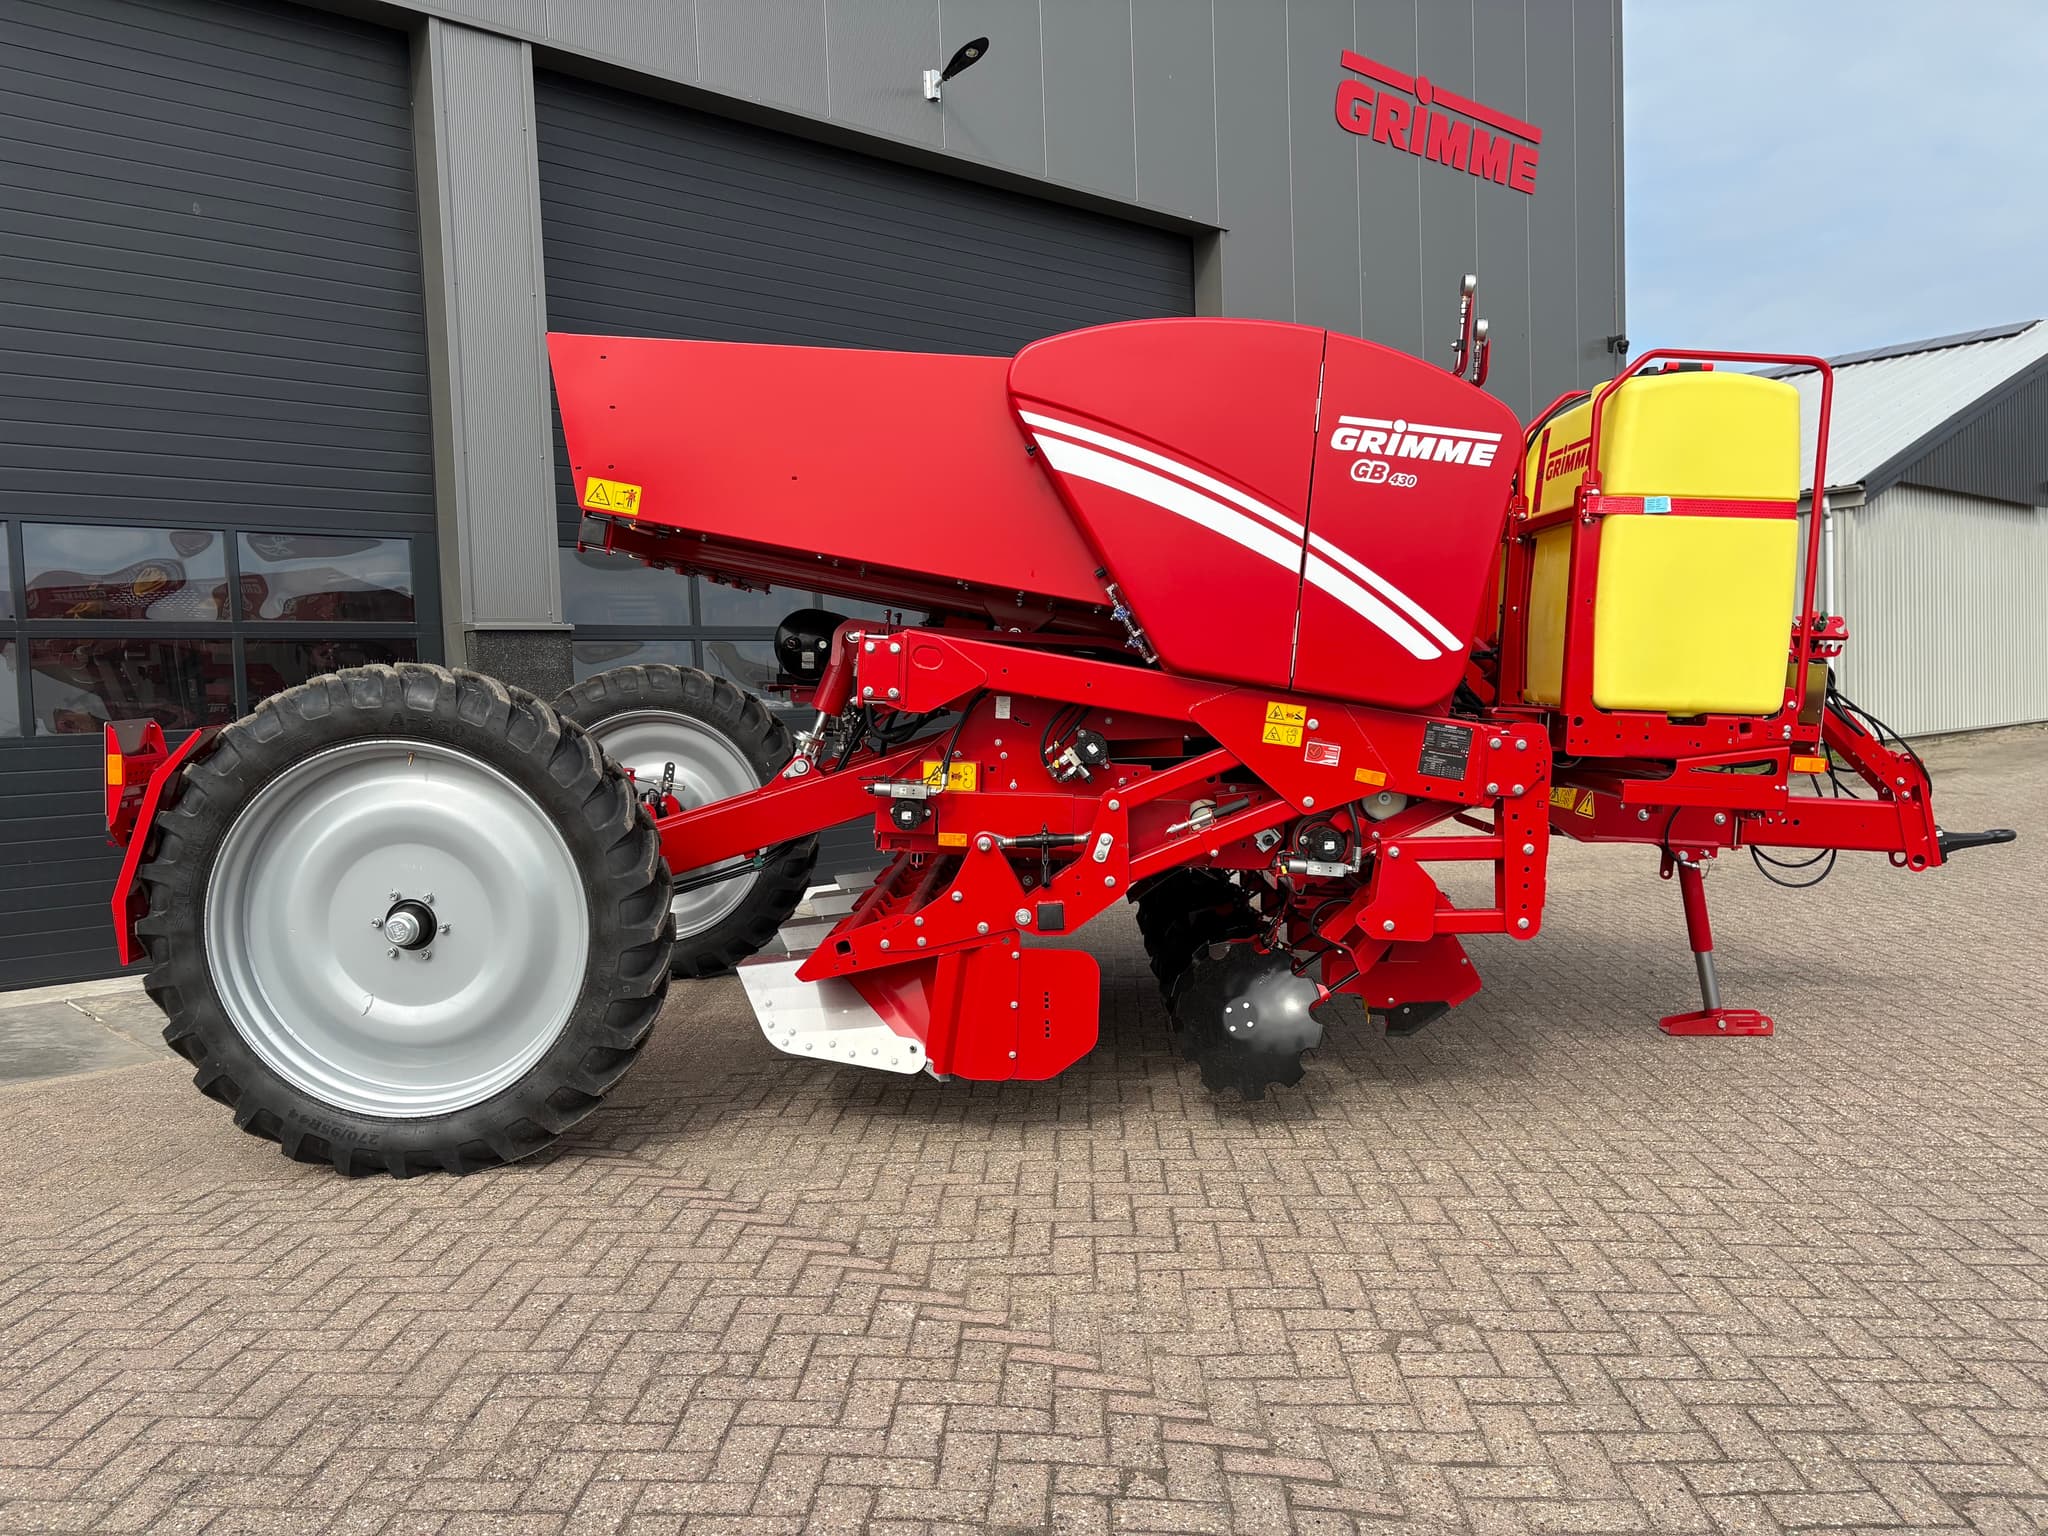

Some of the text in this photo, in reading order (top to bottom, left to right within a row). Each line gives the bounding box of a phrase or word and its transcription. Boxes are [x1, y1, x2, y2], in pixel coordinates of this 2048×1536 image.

[1335, 76, 1540, 195] GRIMME
[1330, 419, 1499, 467] GRIMME
[1546, 444, 1590, 481] GRIMM
[1351, 459, 1418, 488] GB 430
